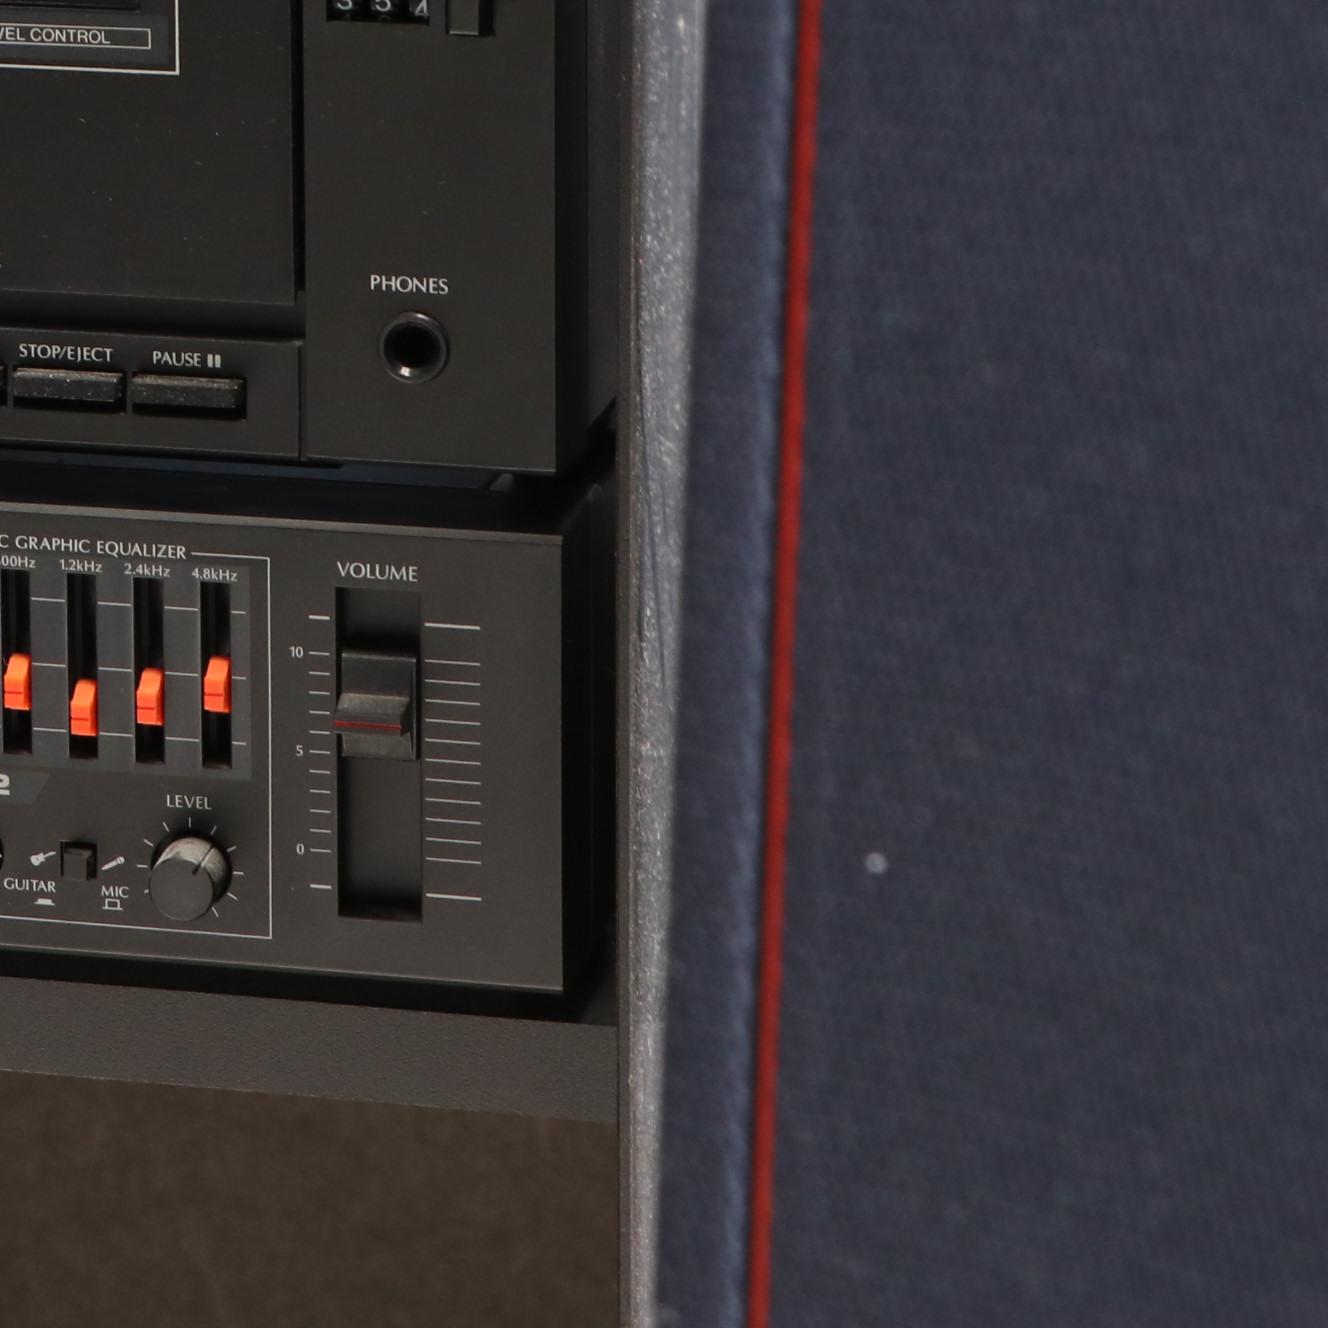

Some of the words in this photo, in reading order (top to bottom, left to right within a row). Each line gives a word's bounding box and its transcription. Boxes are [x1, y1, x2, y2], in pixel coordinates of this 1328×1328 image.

[30, 27, 110, 45] CONTROL
[370, 274, 449, 295] PHONES
[19, 343, 113, 362] STOP/EJECT
[152, 351, 201, 367] PAUSE
[336, 561, 418, 583] VOLUME
